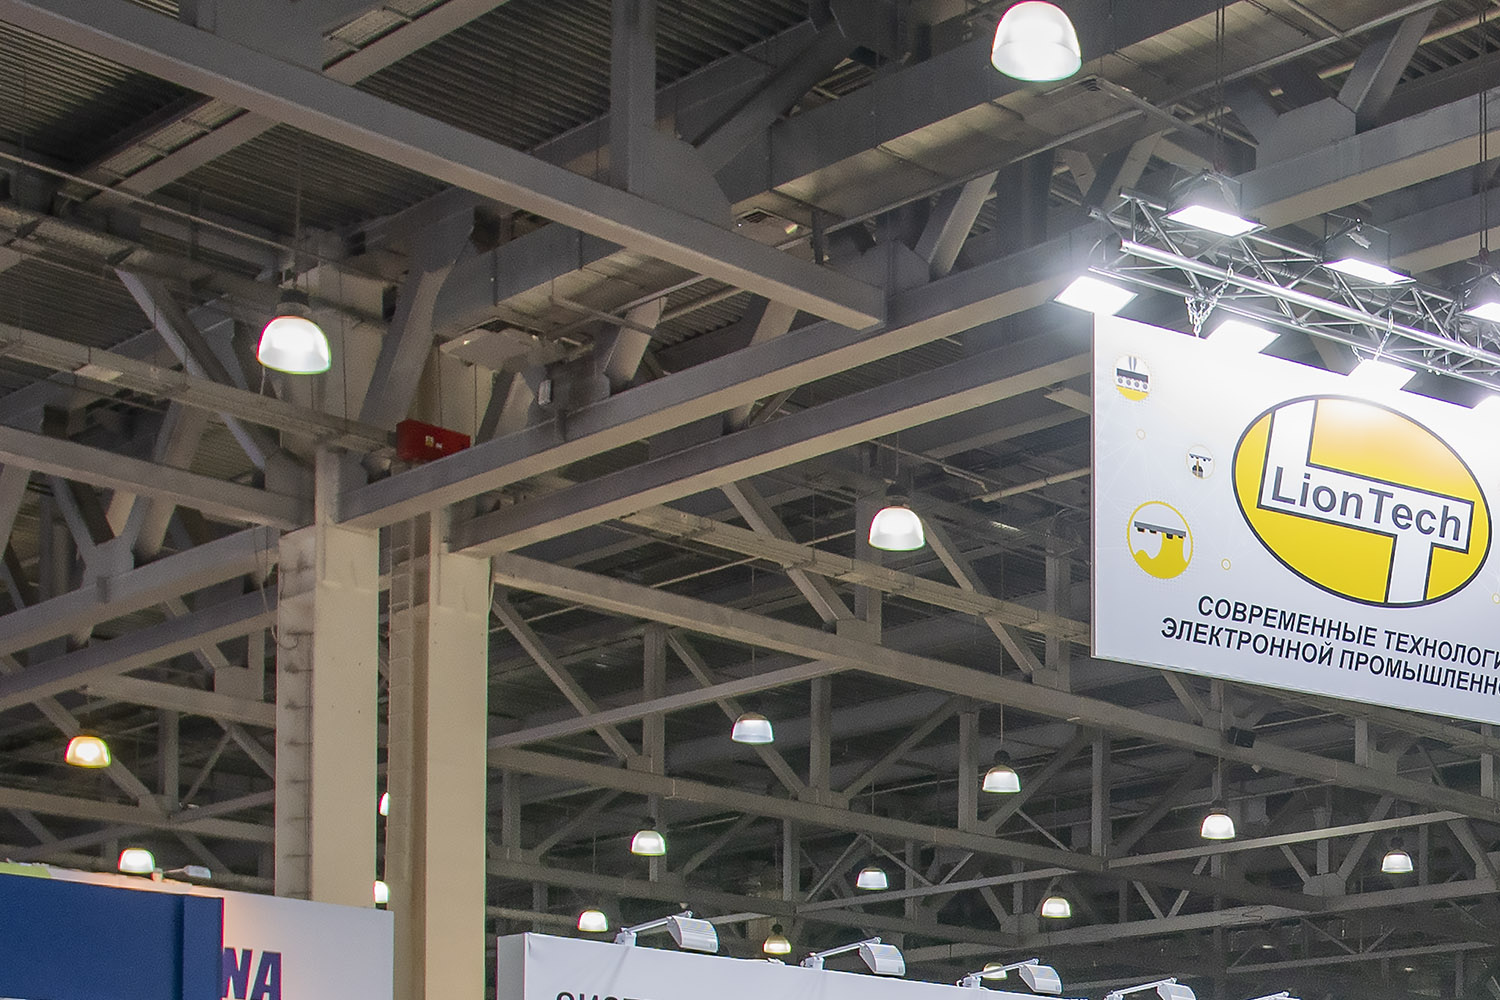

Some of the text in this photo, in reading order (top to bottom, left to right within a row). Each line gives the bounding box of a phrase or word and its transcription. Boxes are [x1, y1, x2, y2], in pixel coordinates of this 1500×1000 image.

[1269, 466, 1463, 542] LionTech
[1160, 616, 1334, 667] ЭЛЕКТРОННОЙ
[1197, 595, 1378, 648] СОВРЕМЕННЫЕ
